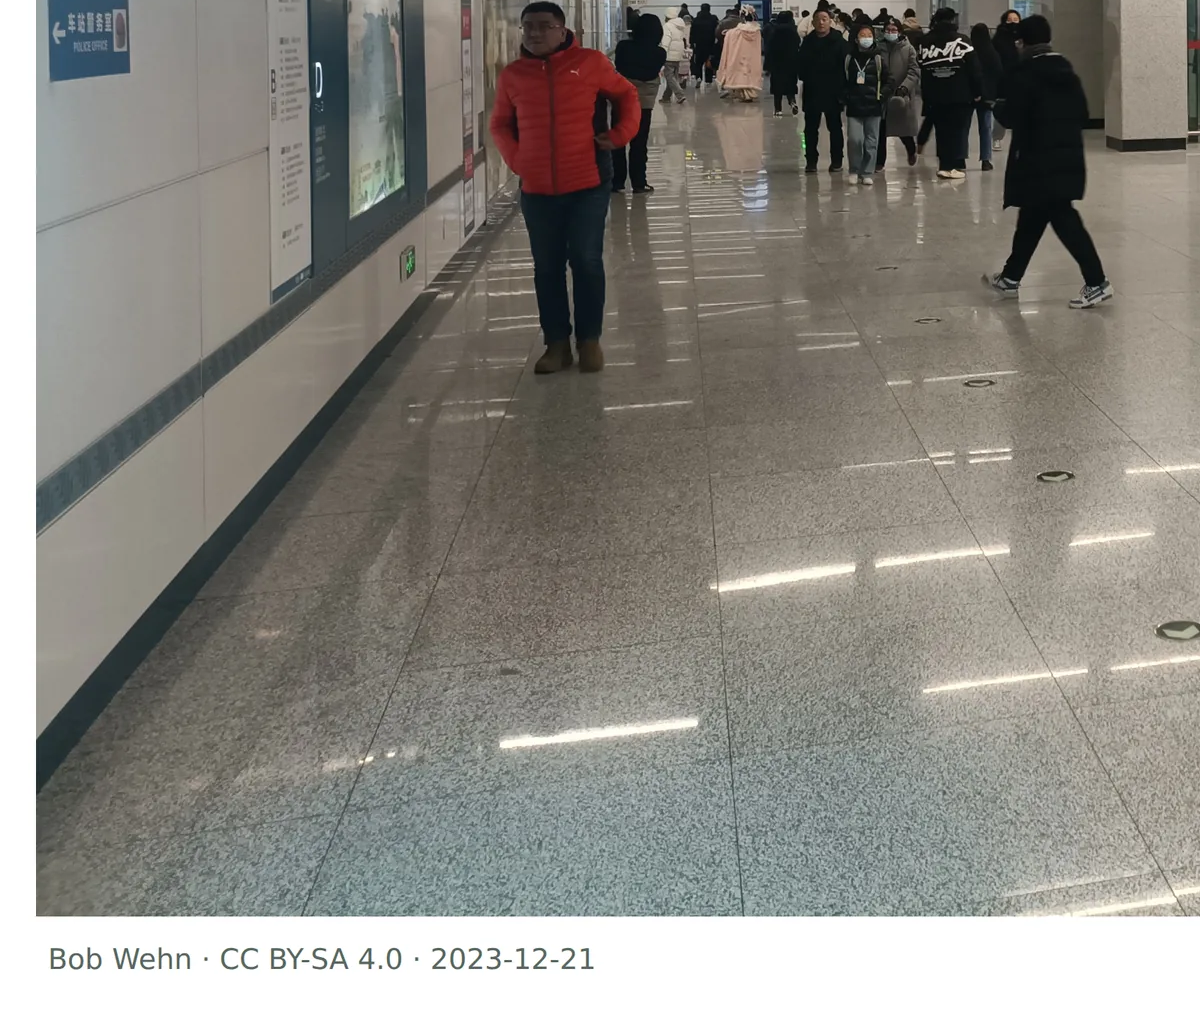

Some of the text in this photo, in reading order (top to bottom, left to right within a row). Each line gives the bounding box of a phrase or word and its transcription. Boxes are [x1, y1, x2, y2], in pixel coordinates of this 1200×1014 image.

[68, 12, 112, 34] 车站警务室
[73, 39, 108, 53] POLICE OFFICE
[315, 62, 323, 98] D
